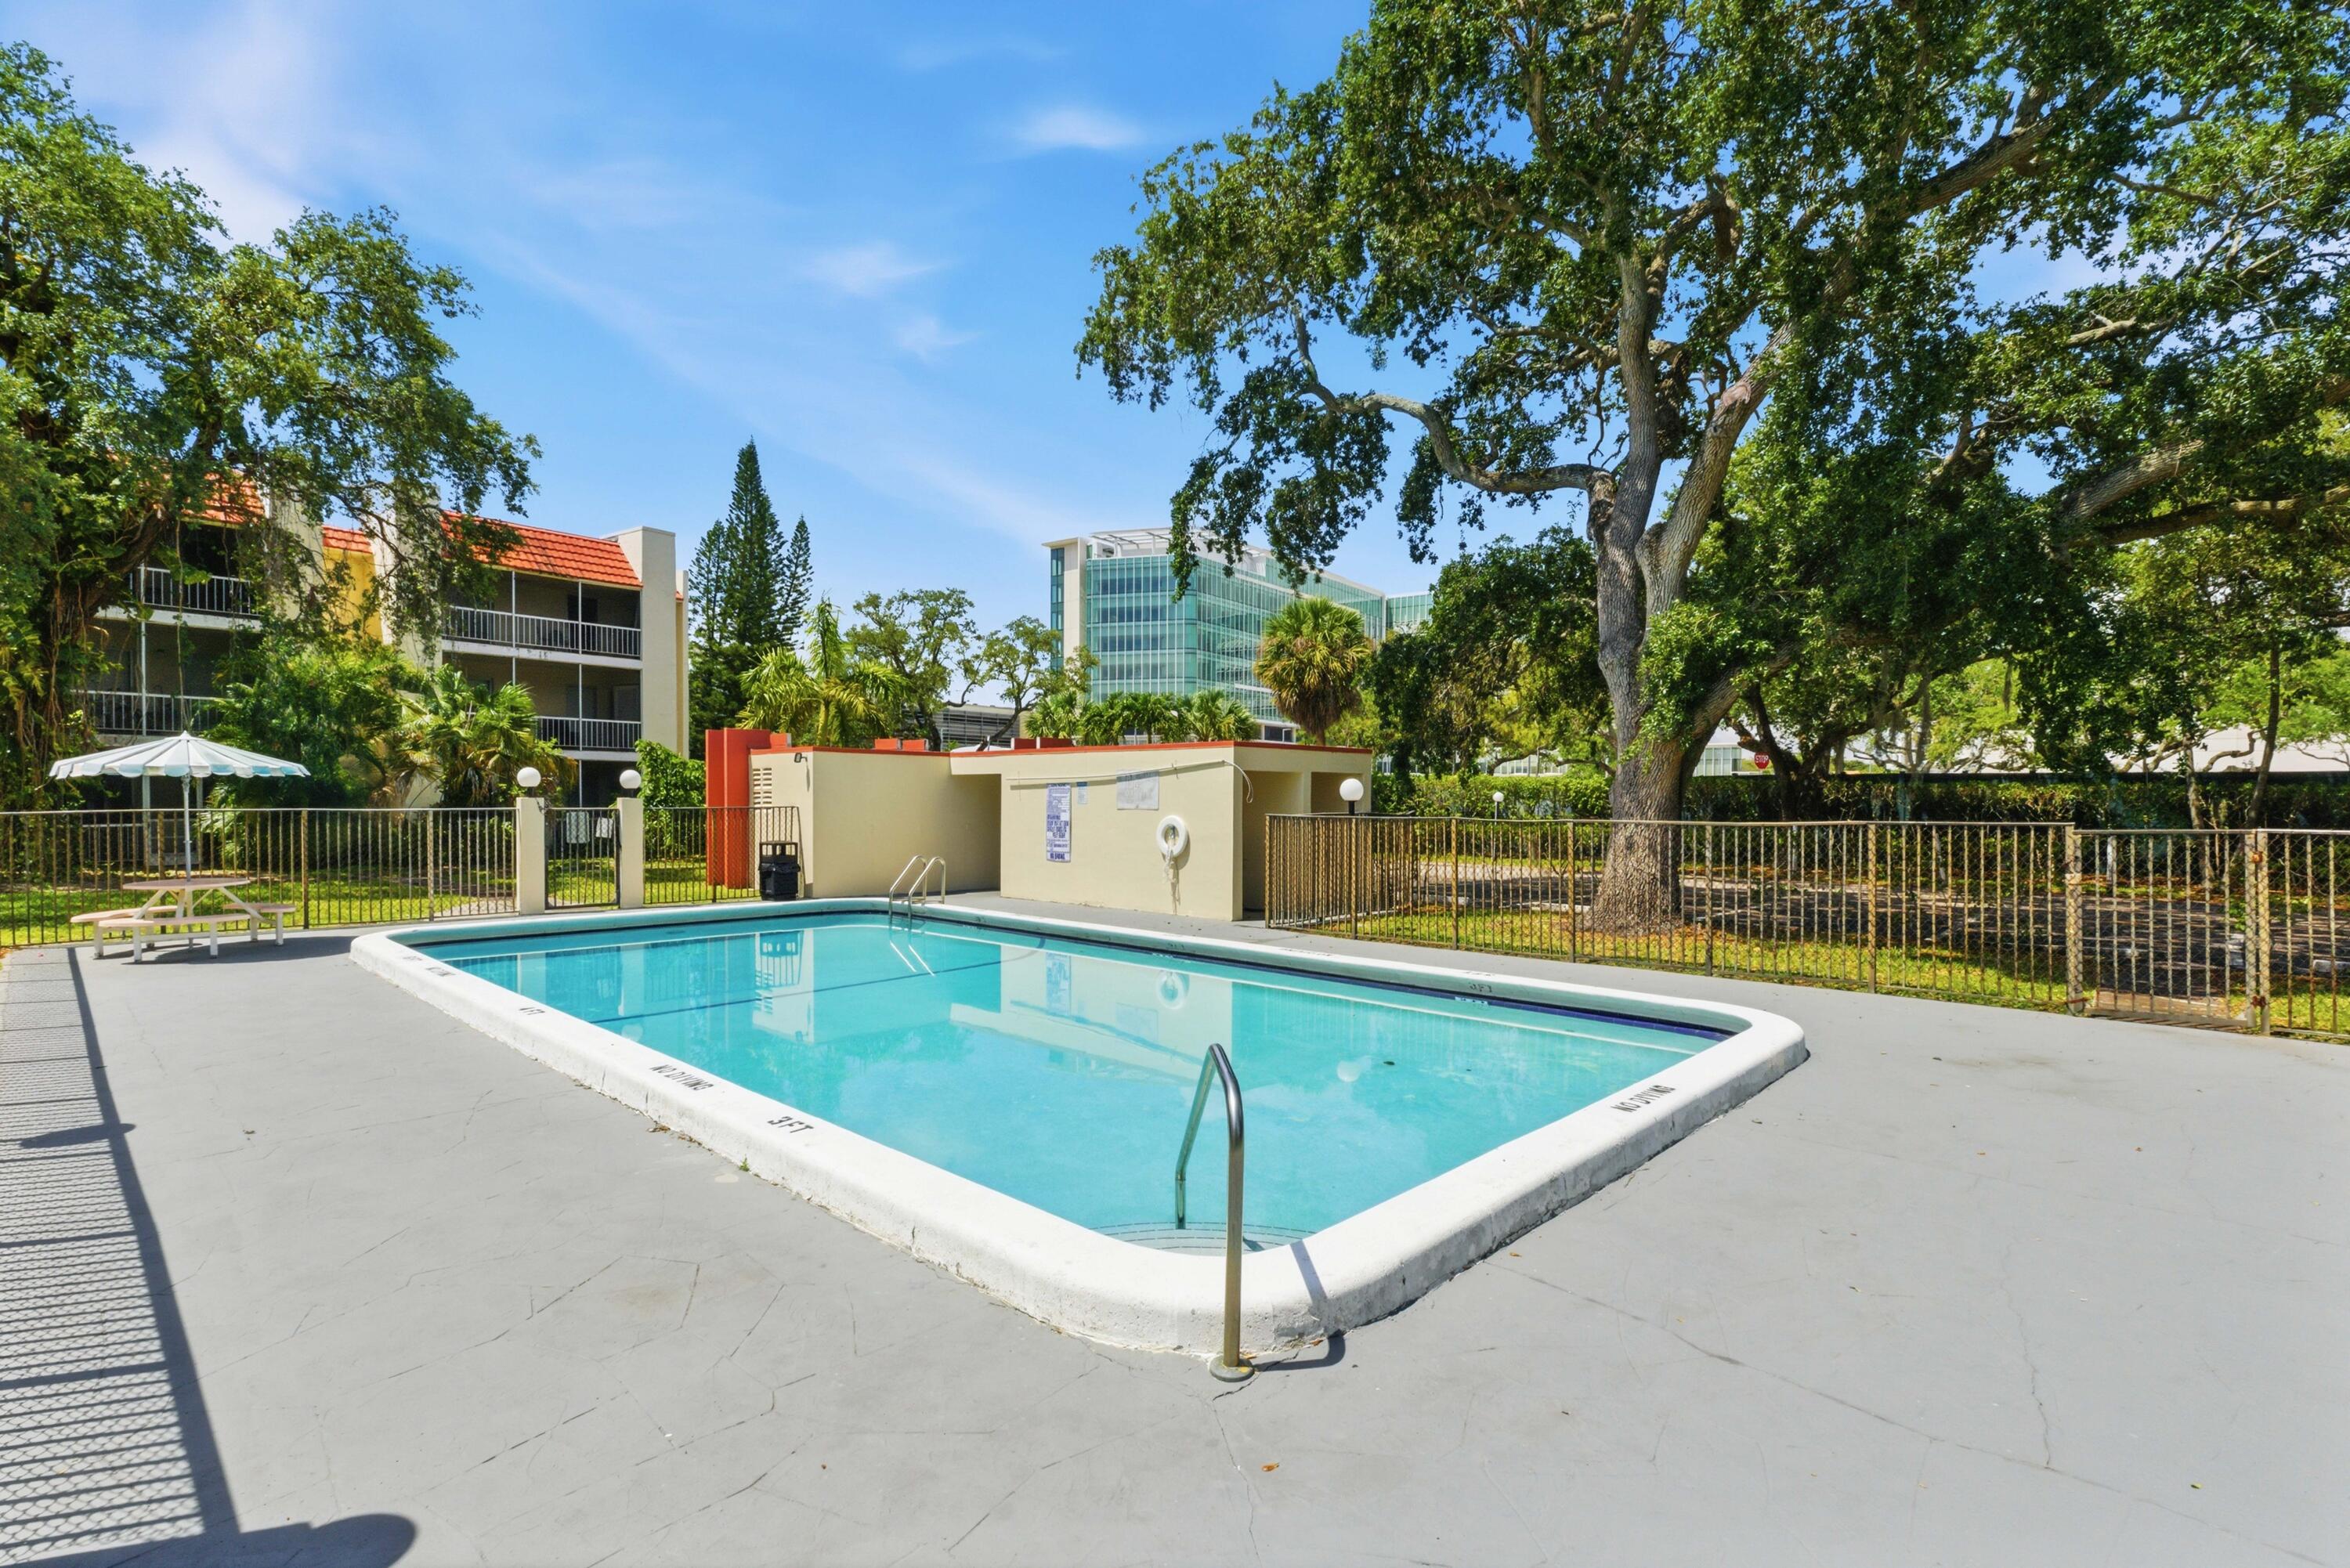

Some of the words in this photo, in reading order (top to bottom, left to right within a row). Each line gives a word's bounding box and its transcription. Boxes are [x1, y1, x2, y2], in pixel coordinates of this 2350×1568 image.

[649, 1064, 676, 1074] NO
[664, 1072, 714, 1091] DIVING
[1611, 1101, 1642, 1112] NO
[1629, 1085, 1676, 1104] DIVING
